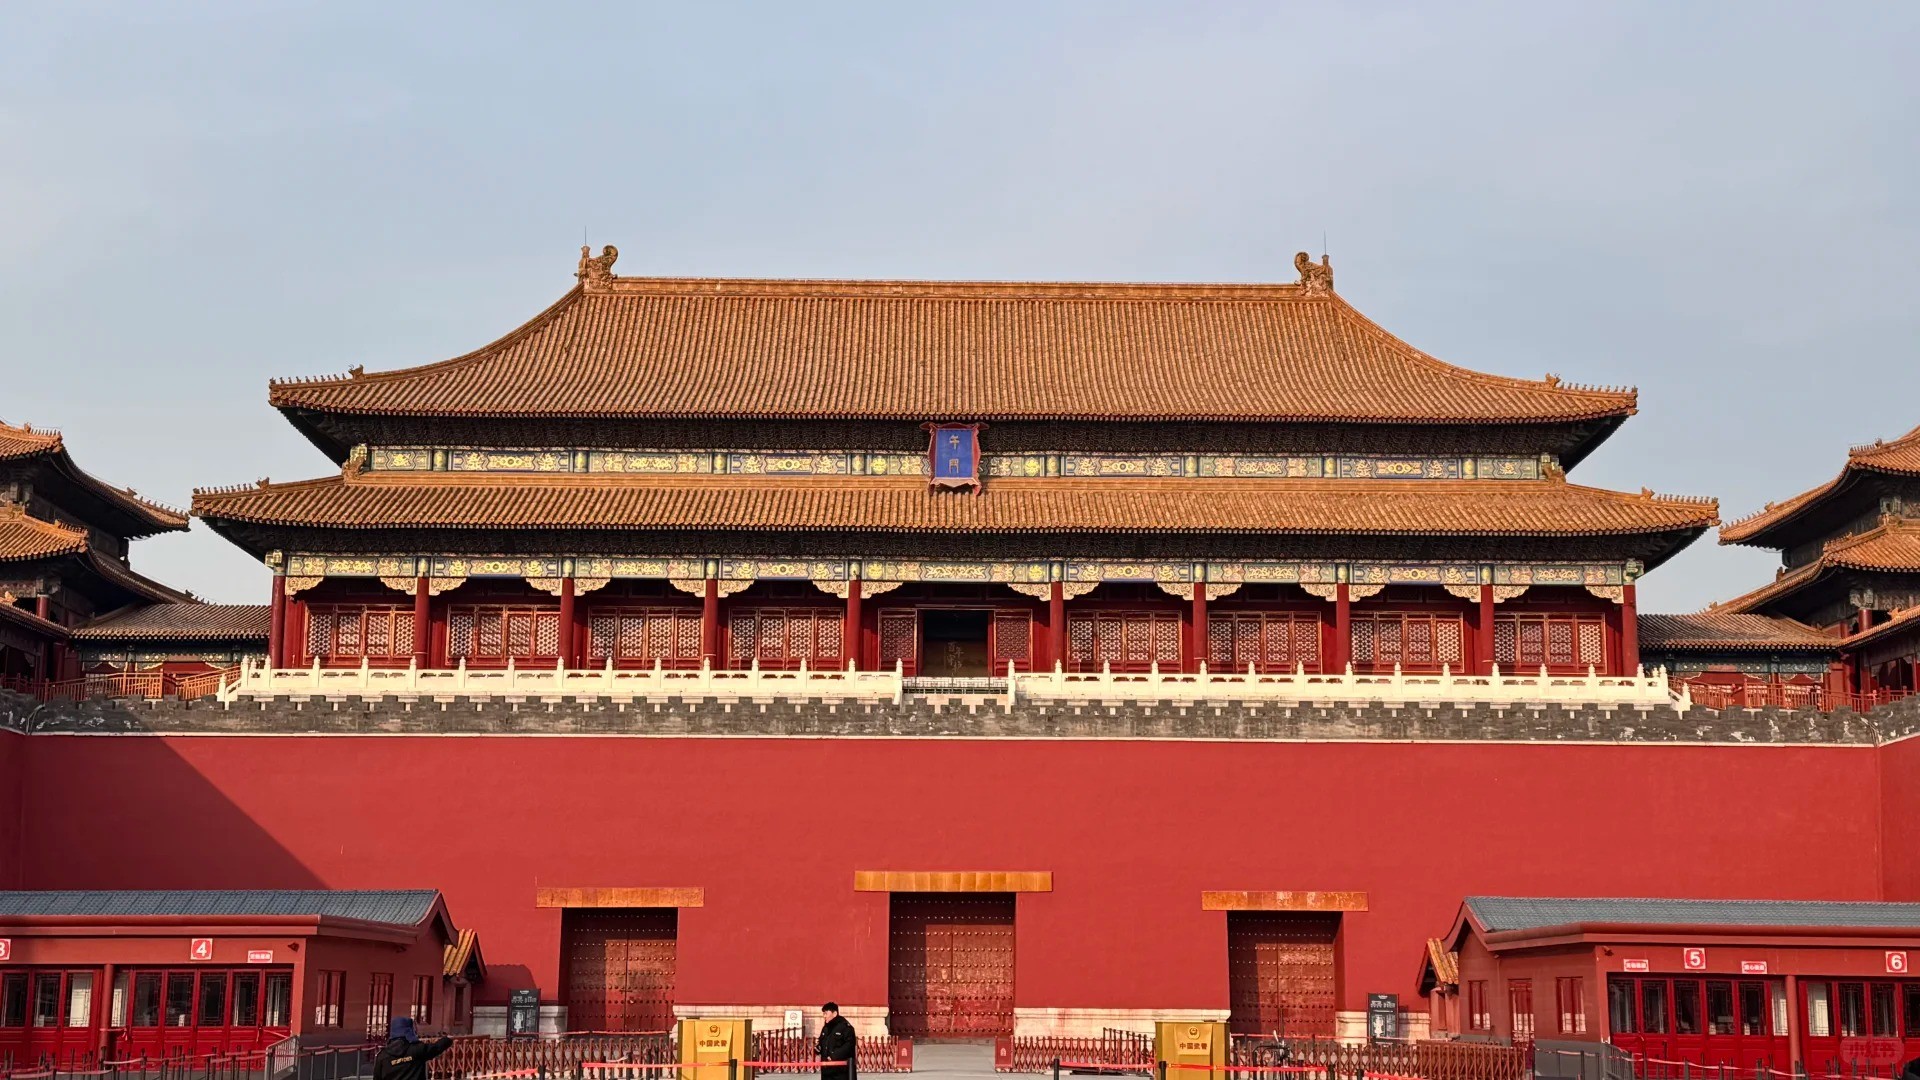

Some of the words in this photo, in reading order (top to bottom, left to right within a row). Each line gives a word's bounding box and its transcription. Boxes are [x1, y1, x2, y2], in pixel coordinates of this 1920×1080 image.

[196, 941, 207, 957] 4
[1690, 951, 1701, 967] 5
[1891, 954, 1902, 970] 6
[1180, 1042, 1207, 1050] 中国武警
